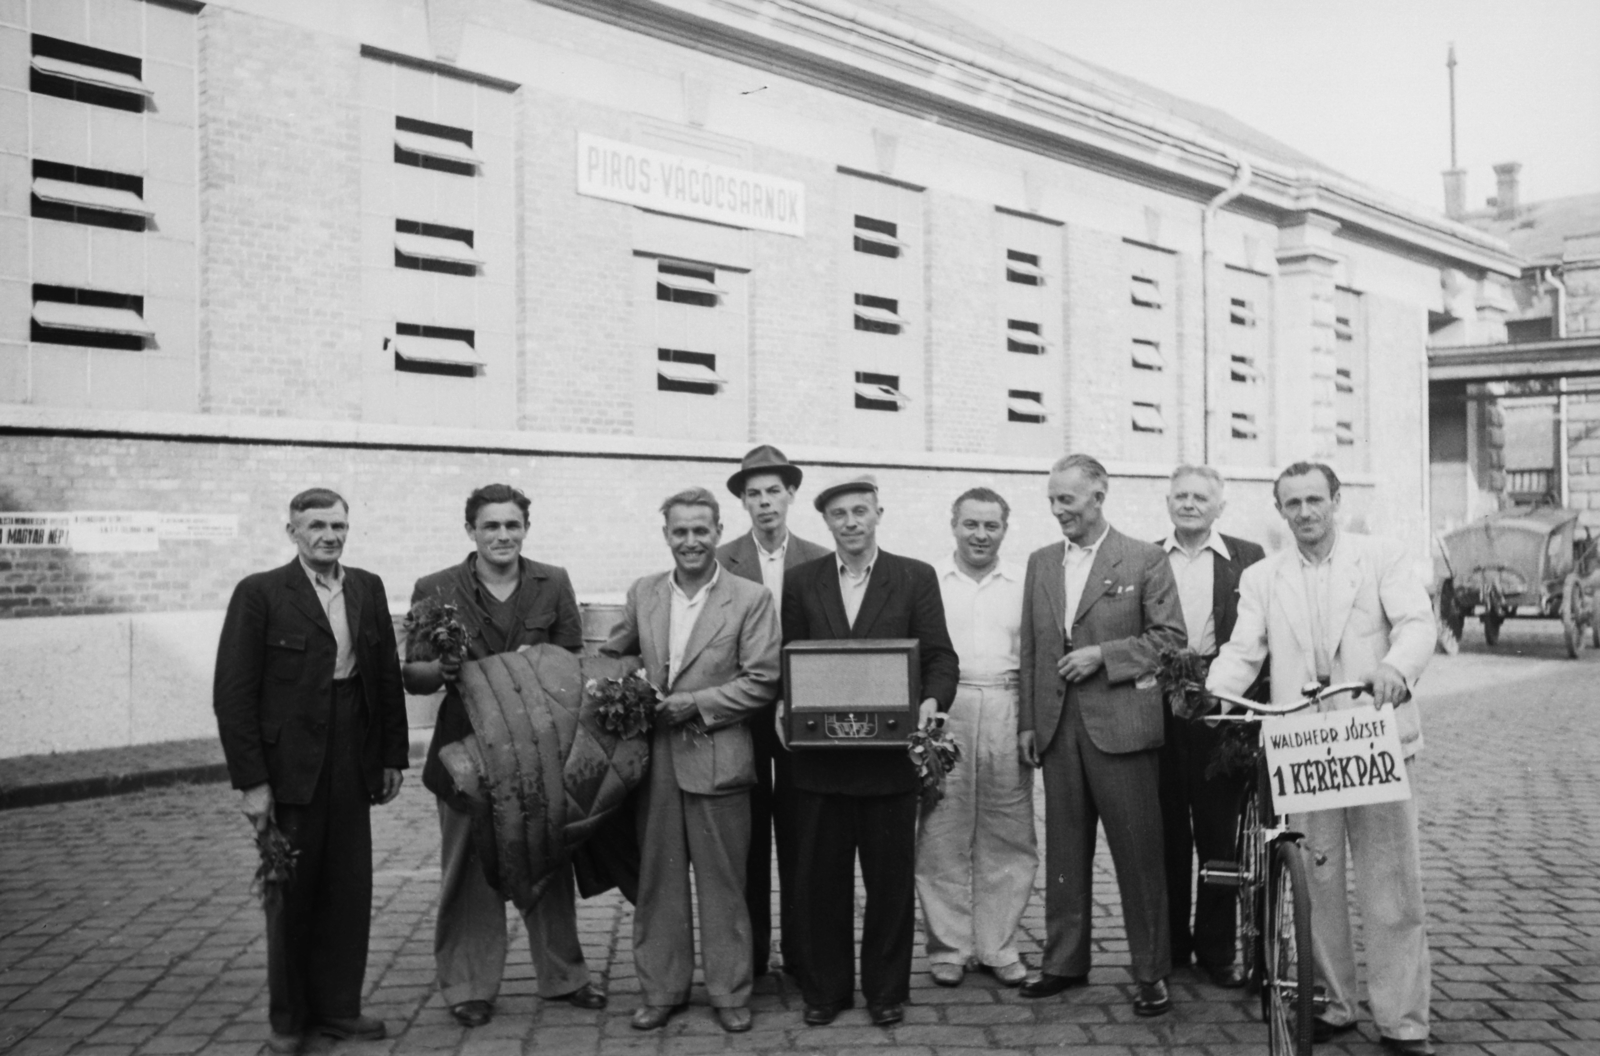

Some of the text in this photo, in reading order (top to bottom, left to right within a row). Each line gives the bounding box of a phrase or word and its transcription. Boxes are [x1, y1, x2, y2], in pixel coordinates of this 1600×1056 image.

[6, 528, 45, 544] MAGYAR
[1270, 716, 1387, 750] WALDHERR JÓZSEF
[1272, 742, 1402, 797] 1 KERÉKPÁR
